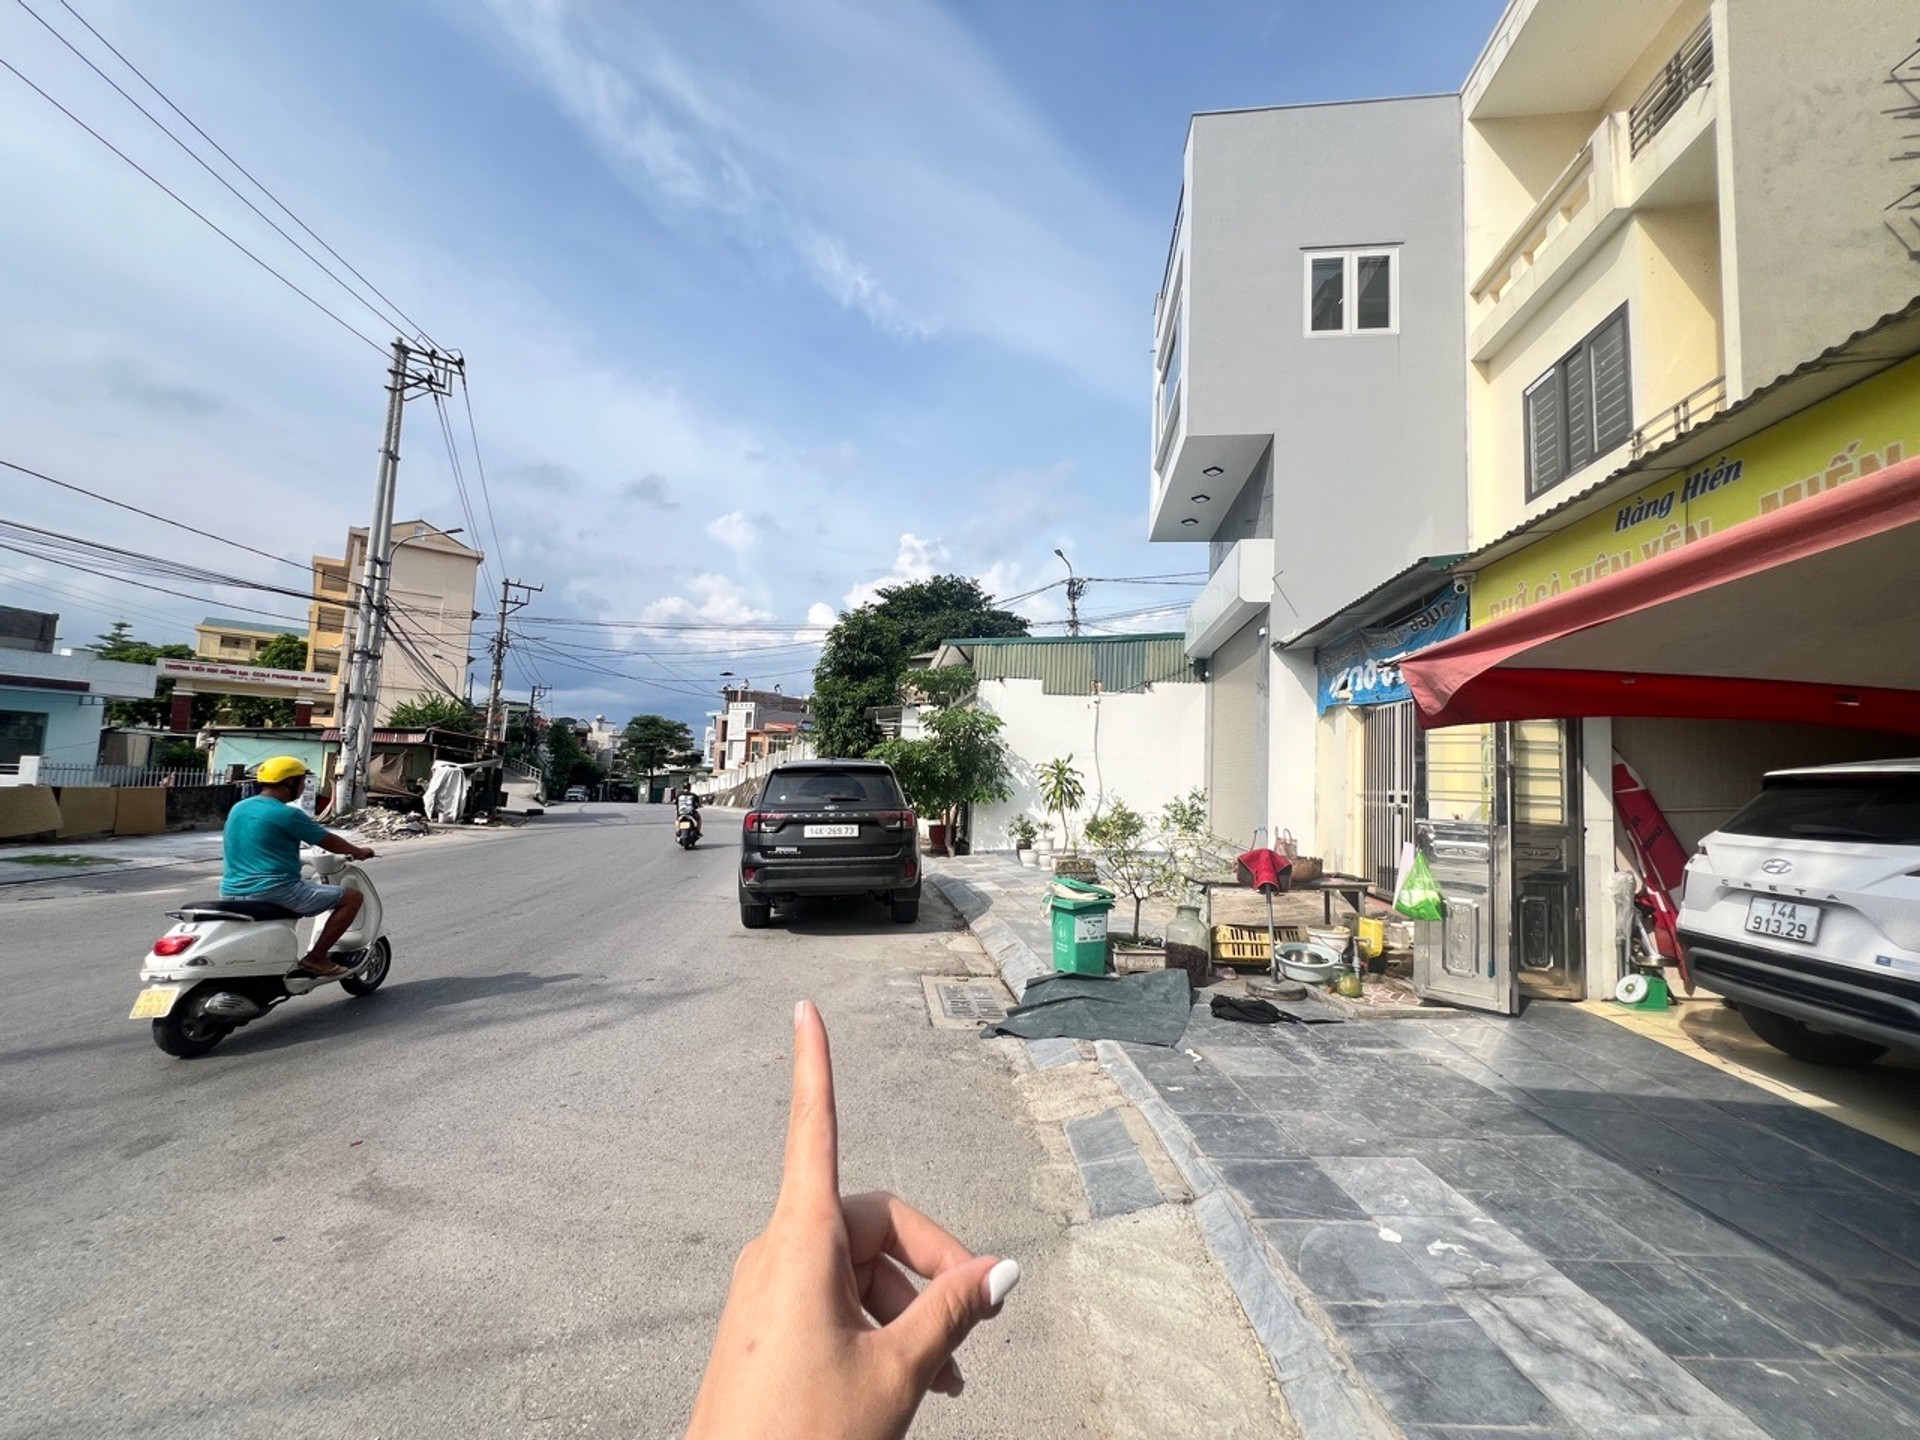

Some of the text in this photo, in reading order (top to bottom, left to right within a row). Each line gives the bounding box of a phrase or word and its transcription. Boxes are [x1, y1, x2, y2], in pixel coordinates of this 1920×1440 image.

[1681, 456, 1743, 503] Hiền
[1721, 878, 1839, 900] CRETA
[1770, 902, 1796, 920] 14A
[1752, 916, 1808, 939] 913.29
